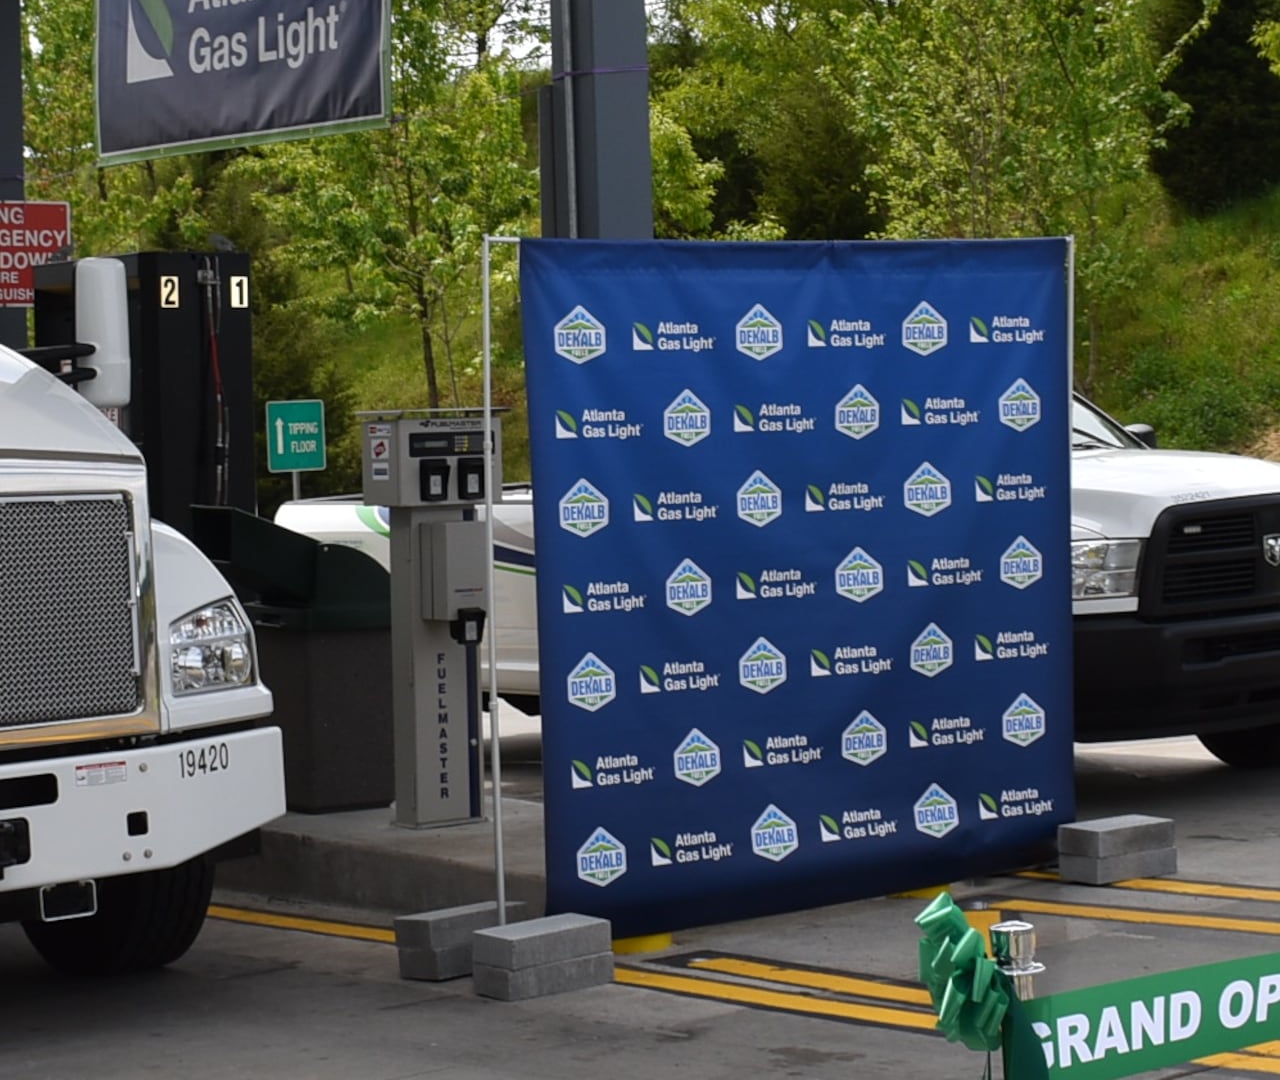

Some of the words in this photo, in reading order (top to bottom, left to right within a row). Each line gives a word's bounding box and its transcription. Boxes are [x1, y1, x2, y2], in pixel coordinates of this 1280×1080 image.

[189, 27, 248, 73] Gas
[163, 279, 177, 305] 2
[234, 280, 245, 305] 1
[658, 322, 698, 334] Atlanta
[831, 320, 870, 331] Atlanta
[992, 316, 1029, 327] Atlanta
[558, 329, 602, 347] DEKALB
[740, 327, 779, 344] DEKALB
[906, 323, 944, 340] DEKALB
[993, 330, 1013, 342] Gas
[1016, 330, 1043, 344] Light
[658, 337, 680, 350] Gas
[683, 337, 713, 352] Light
[831, 334, 852, 346] Gas
[855, 334, 884, 348] Light
[759, 404, 801, 416] Atlanta
[925, 398, 965, 409] Atlanta
[1002, 399, 1037, 416] DEKALB
[582, 409, 625, 422] Atlanta
[668, 412, 707, 430] DEKALB
[839, 406, 876, 423] DEKALB
[925, 412, 947, 424] Gas
[950, 411, 978, 425] Light
[288, 422, 318, 435] TIPPING
[583, 425, 606, 438] Gas
[608, 424, 640, 439] Light
[759, 419, 783, 431] Gas
[786, 418, 814, 433] Light
[291, 440, 317, 453] FLOOR
[997, 474, 1032, 485] Atlanta
[829, 483, 868, 495] Atlanta
[908, 484, 947, 501] DEKALB
[997, 488, 1016, 500] Gas
[1019, 487, 1044, 501] Light
[658, 492, 701, 504] Atlanta
[741, 493, 779, 511] DEKALB
[829, 498, 851, 510] Gas
[854, 496, 883, 511] Light
[563, 502, 604, 520] DEKALB
[658, 508, 682, 520] Gas
[685, 506, 716, 521] Light
[932, 558, 969, 570] Atlanta
[1004, 557, 1039, 574] DEKALB
[760, 570, 801, 582] Atlanta
[839, 569, 879, 586] DEKALB
[932, 573, 954, 585] Gas
[956, 571, 981, 585] Light
[587, 582, 629, 595] Atlanta
[670, 582, 708, 600] DEKALB
[760, 585, 783, 598] Gas
[786, 583, 815, 598] Light
[588, 598, 611, 611] Gas
[614, 596, 644, 611] Light
[997, 631, 1034, 644] Atlanta
[835, 646, 876, 659] Atlanta
[914, 645, 949, 662] DEKALB
[997, 647, 1018, 658] Gas
[1020, 644, 1047, 658] Light
[664, 661, 704, 675] Atlanta
[743, 660, 782, 677] DEKALB
[835, 662, 859, 674] Gas
[861, 659, 891, 674] Light
[572, 677, 612, 695] DEKALB
[664, 678, 687, 691] Gas
[689, 675, 718, 690] Light
[437, 653, 449, 798] FUELMASTER
[932, 717, 970, 730] Atlanta
[1006, 714, 1042, 731] DEKALB
[766, 735, 807, 749] Atlanta
[846, 733, 883, 750] DEKALB
[932, 733, 954, 745] Gas
[957, 729, 983, 744] Light
[179, 742, 229, 778] 19420
[596, 755, 638, 770] Atlanta
[678, 751, 717, 769] DEKALB
[767, 752, 789, 765] Gas
[792, 748, 821, 763] Light
[597, 773, 620, 785] Gas
[623, 768, 653, 784] Light
[1001, 788, 1038, 802] Atlanta
[918, 805, 956, 822] DEKALB
[1002, 805, 1023, 817] Gas
[1025, 800, 1052, 815] Light
[842, 809, 881, 824] Atlanta
[755, 827, 794, 845] DEKALB
[844, 826, 866, 839] Gas
[868, 821, 896, 837] Light
[675, 832, 716, 847] Atlanta
[581, 851, 622, 869] DEKALB
[676, 850, 699, 862] Gas
[702, 844, 731, 860] Light
